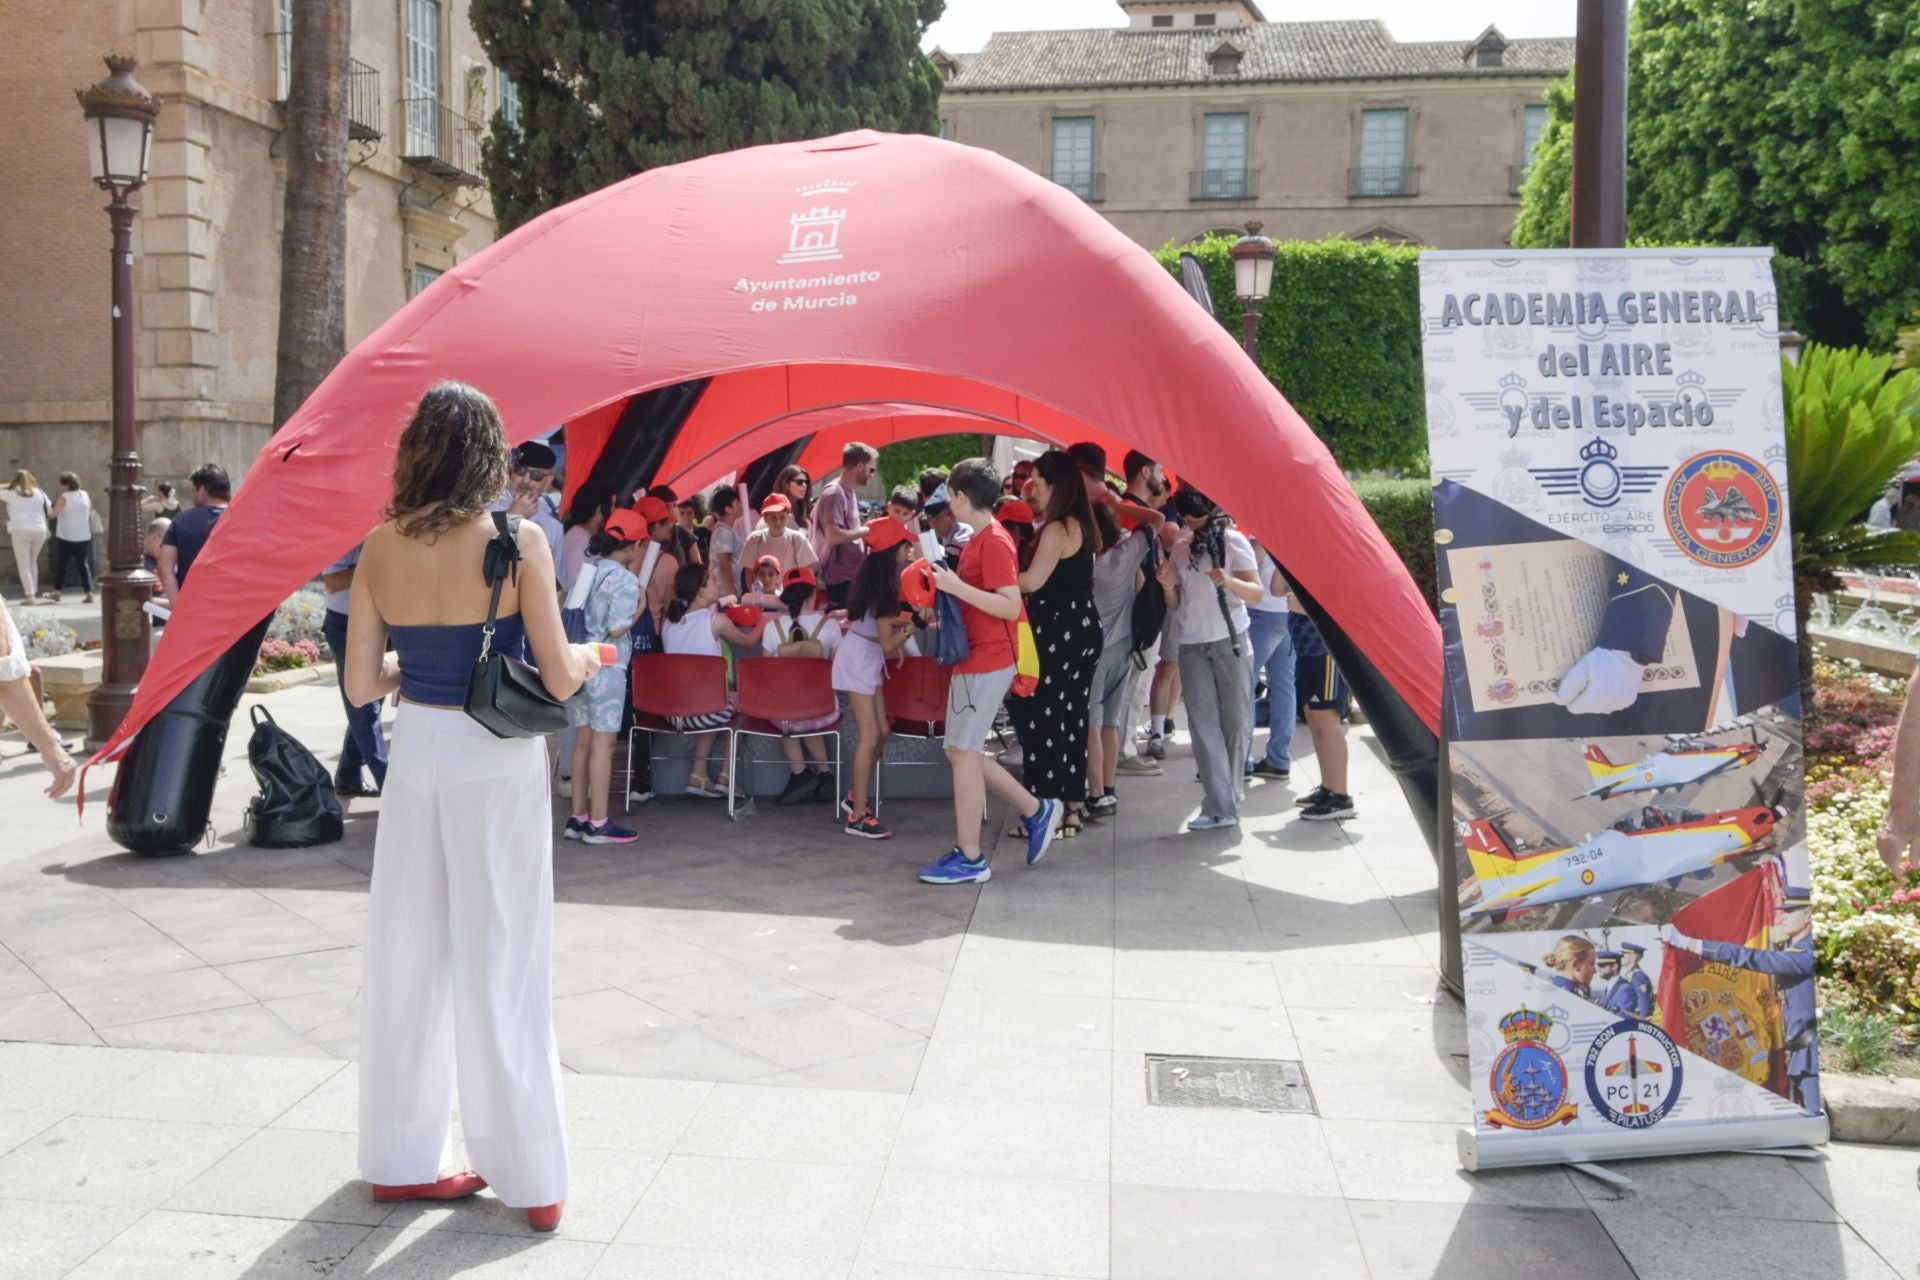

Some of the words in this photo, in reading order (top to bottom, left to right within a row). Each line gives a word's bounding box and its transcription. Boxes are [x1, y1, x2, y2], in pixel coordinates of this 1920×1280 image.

[734, 270, 881, 293] Ayuntamiento
[751, 298, 778, 312] de
[783, 292, 858, 310] Murcia
[1442, 291, 1609, 327] ACADEMIA
[1617, 289, 1764, 324] GENERAL
[1538, 343, 1590, 377] del
[1600, 343, 1673, 376] AIRE
[1504, 404, 1523, 439] y
[1531, 395, 1583, 430] del
[1592, 393, 1714, 436] Espacio
[1753, 468, 1778, 501] AIRE
[1626, 511, 1655, 522] AIRE
[1669, 472, 1692, 549] ACADEMIA
[1602, 523, 1656, 534] ESPACIO
[1763, 511, 1778, 538] DEL
[1695, 542, 1765, 564] GENERAL
[1564, 847, 1604, 868] 792-04
[1587, 1047, 1599, 1067] 792
[1638, 1022, 1680, 1068] INSTRUCTOR
[1606, 1084, 1629, 1101] PC
[1643, 1083, 1660, 1098] 21
[1617, 1112, 1659, 1127] PILATUS
